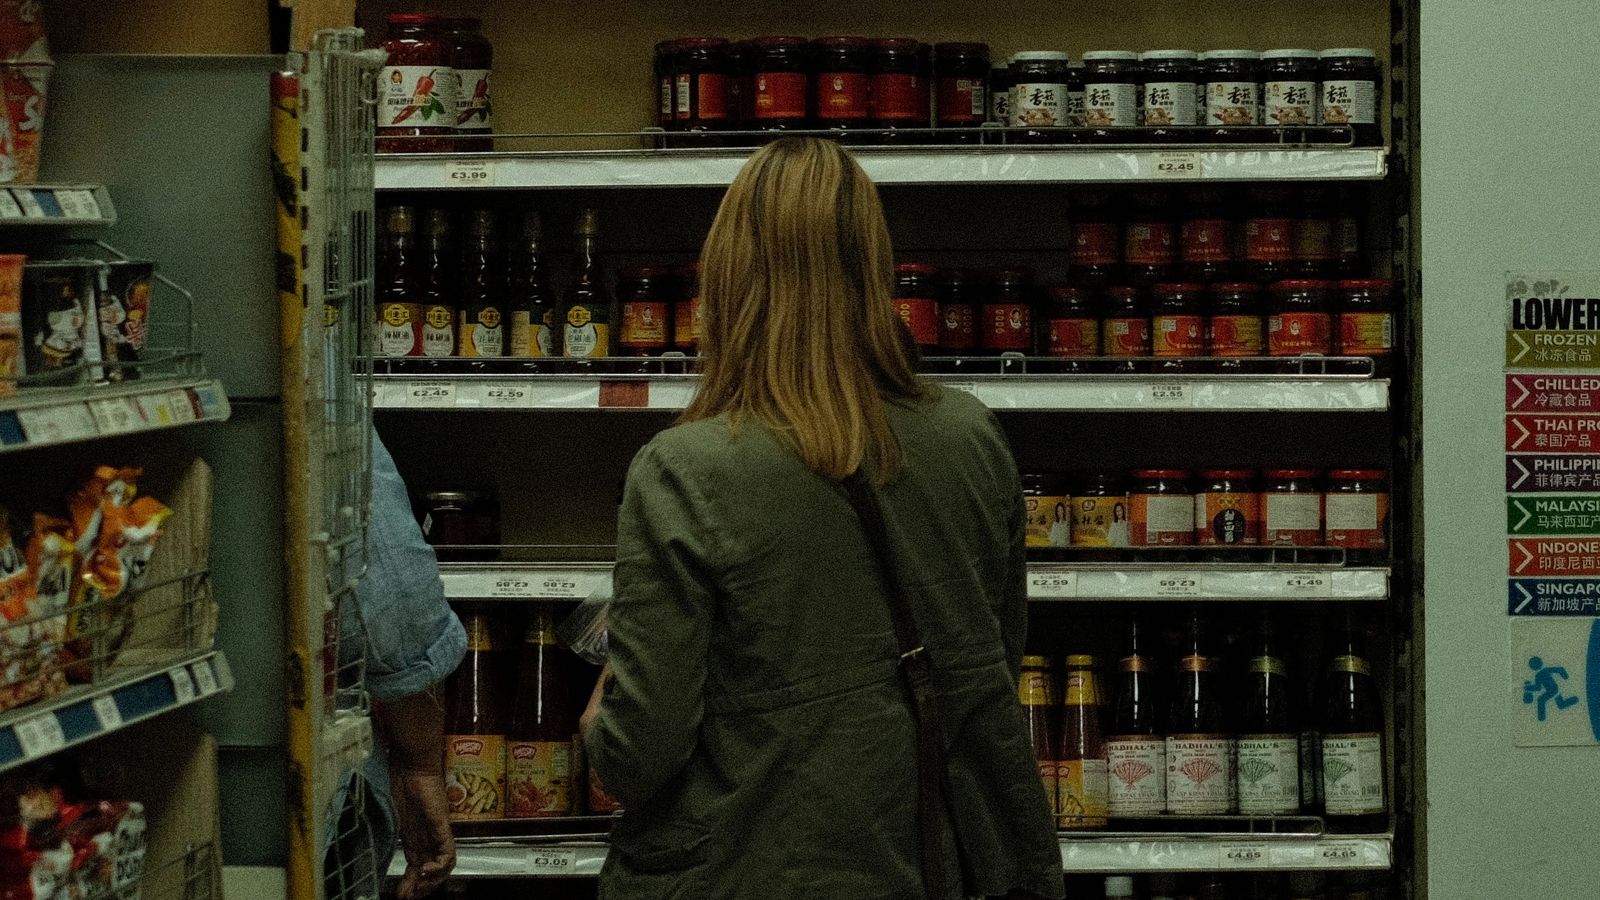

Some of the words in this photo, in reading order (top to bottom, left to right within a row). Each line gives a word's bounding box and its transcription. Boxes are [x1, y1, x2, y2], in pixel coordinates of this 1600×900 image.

[1158, 163, 1194, 171] £2.45
[1512, 298, 1600, 330] LOWER
[1534, 334, 1597, 346] FROZEN
[1535, 348, 1592, 362] 冰冻食品
[1534, 379, 1600, 390] CHILLED
[488, 390, 524, 398] £2.59
[1534, 392, 1591, 407] 冷藏食品
[1533, 419, 1572, 431] THAI
[1535, 433, 1591, 447] 泰国产品
[1534, 459, 1600, 471] PHILIPPI
[1537, 542, 1600, 554] INDONE
[1227, 851, 1261, 859] £4.65
[1323, 850, 1356, 858] £4.65
[535, 857, 568, 866] £3.05
